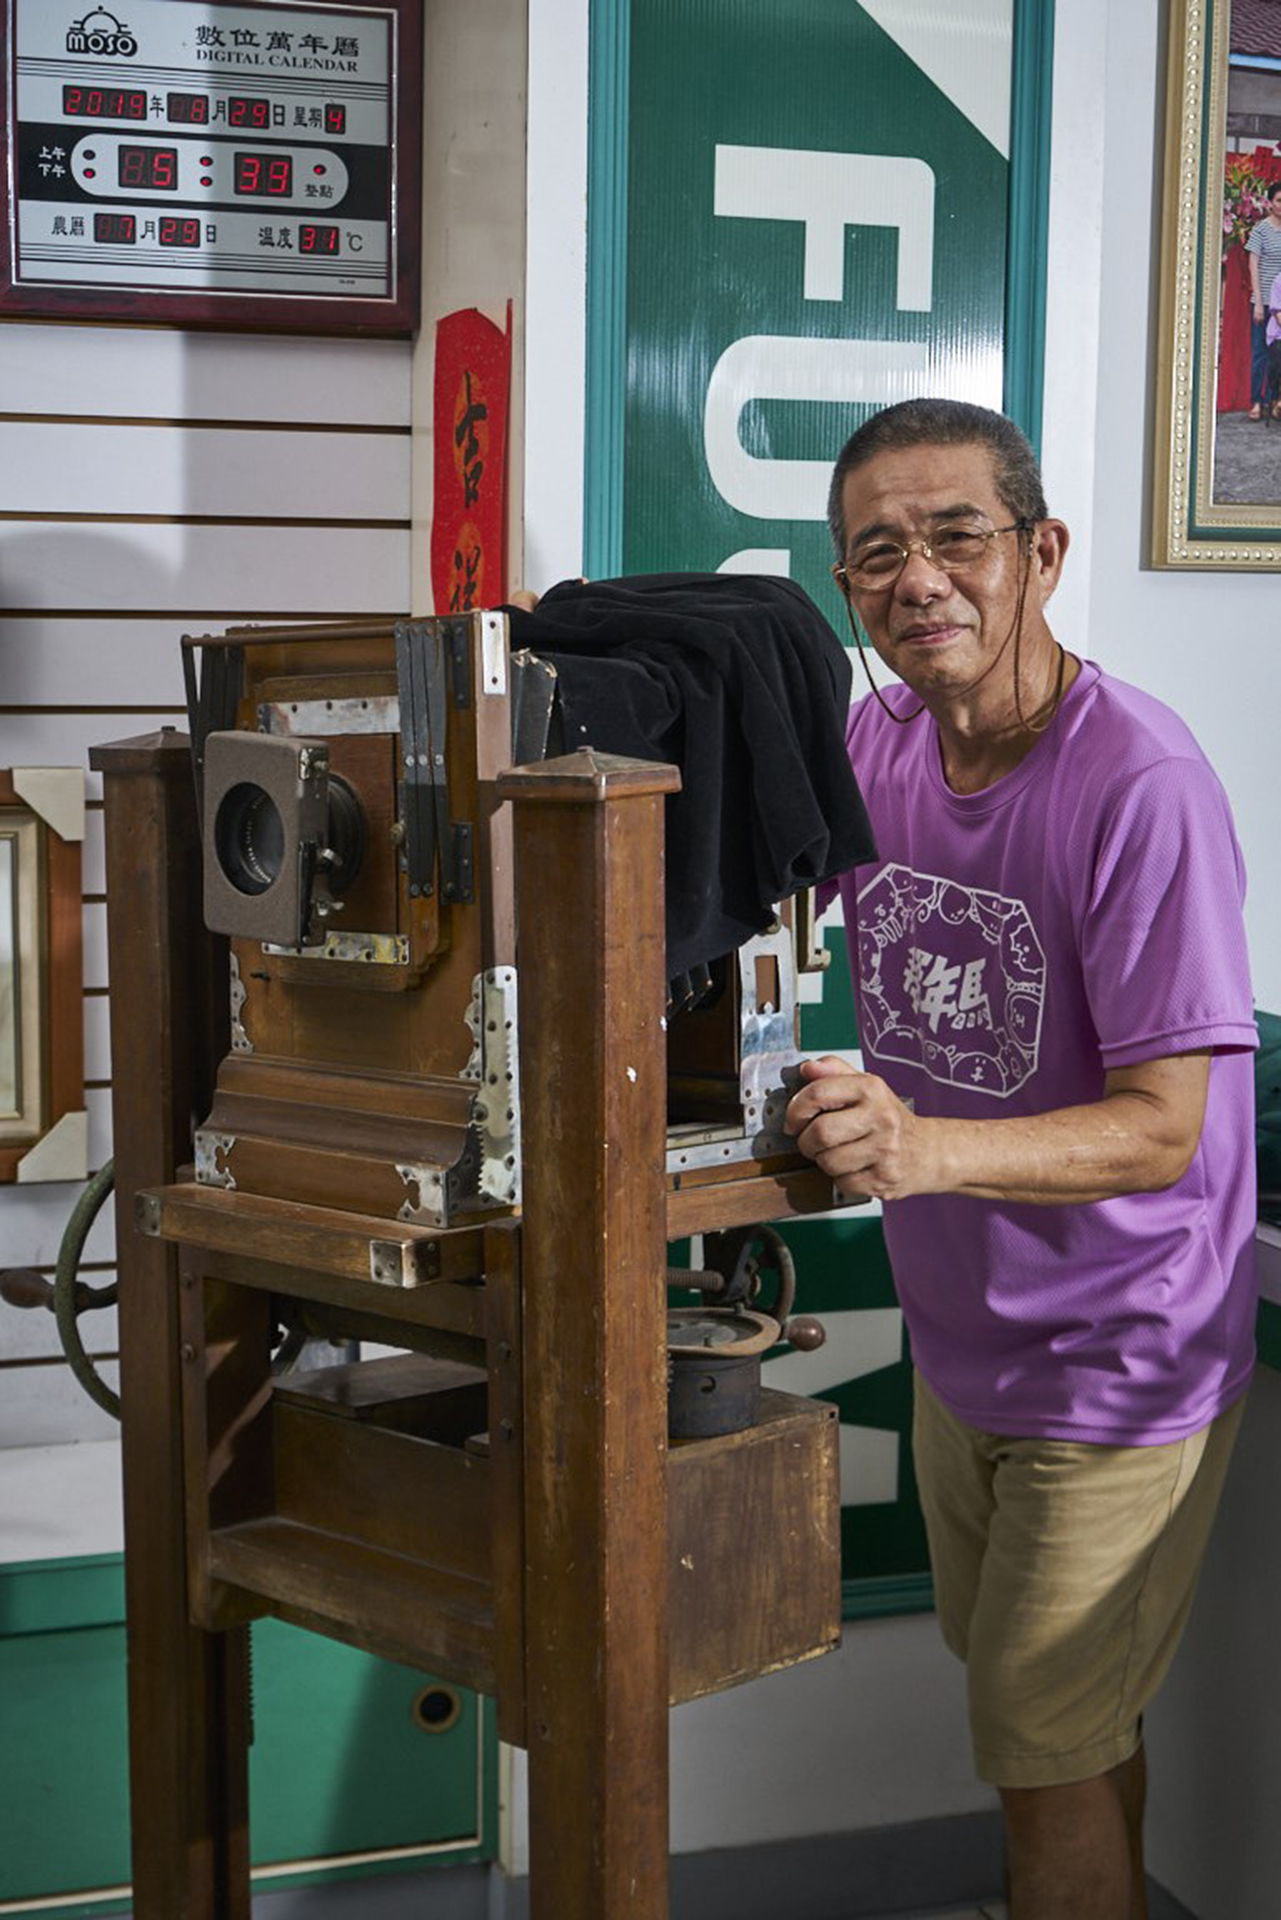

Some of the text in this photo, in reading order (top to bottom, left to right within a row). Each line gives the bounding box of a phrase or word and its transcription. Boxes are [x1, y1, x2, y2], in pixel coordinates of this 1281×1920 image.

[196, 50, 358, 73] DIGITAL CALENDAR
[38, 146, 66, 160] 上午
[38, 163, 66, 178] 下午
